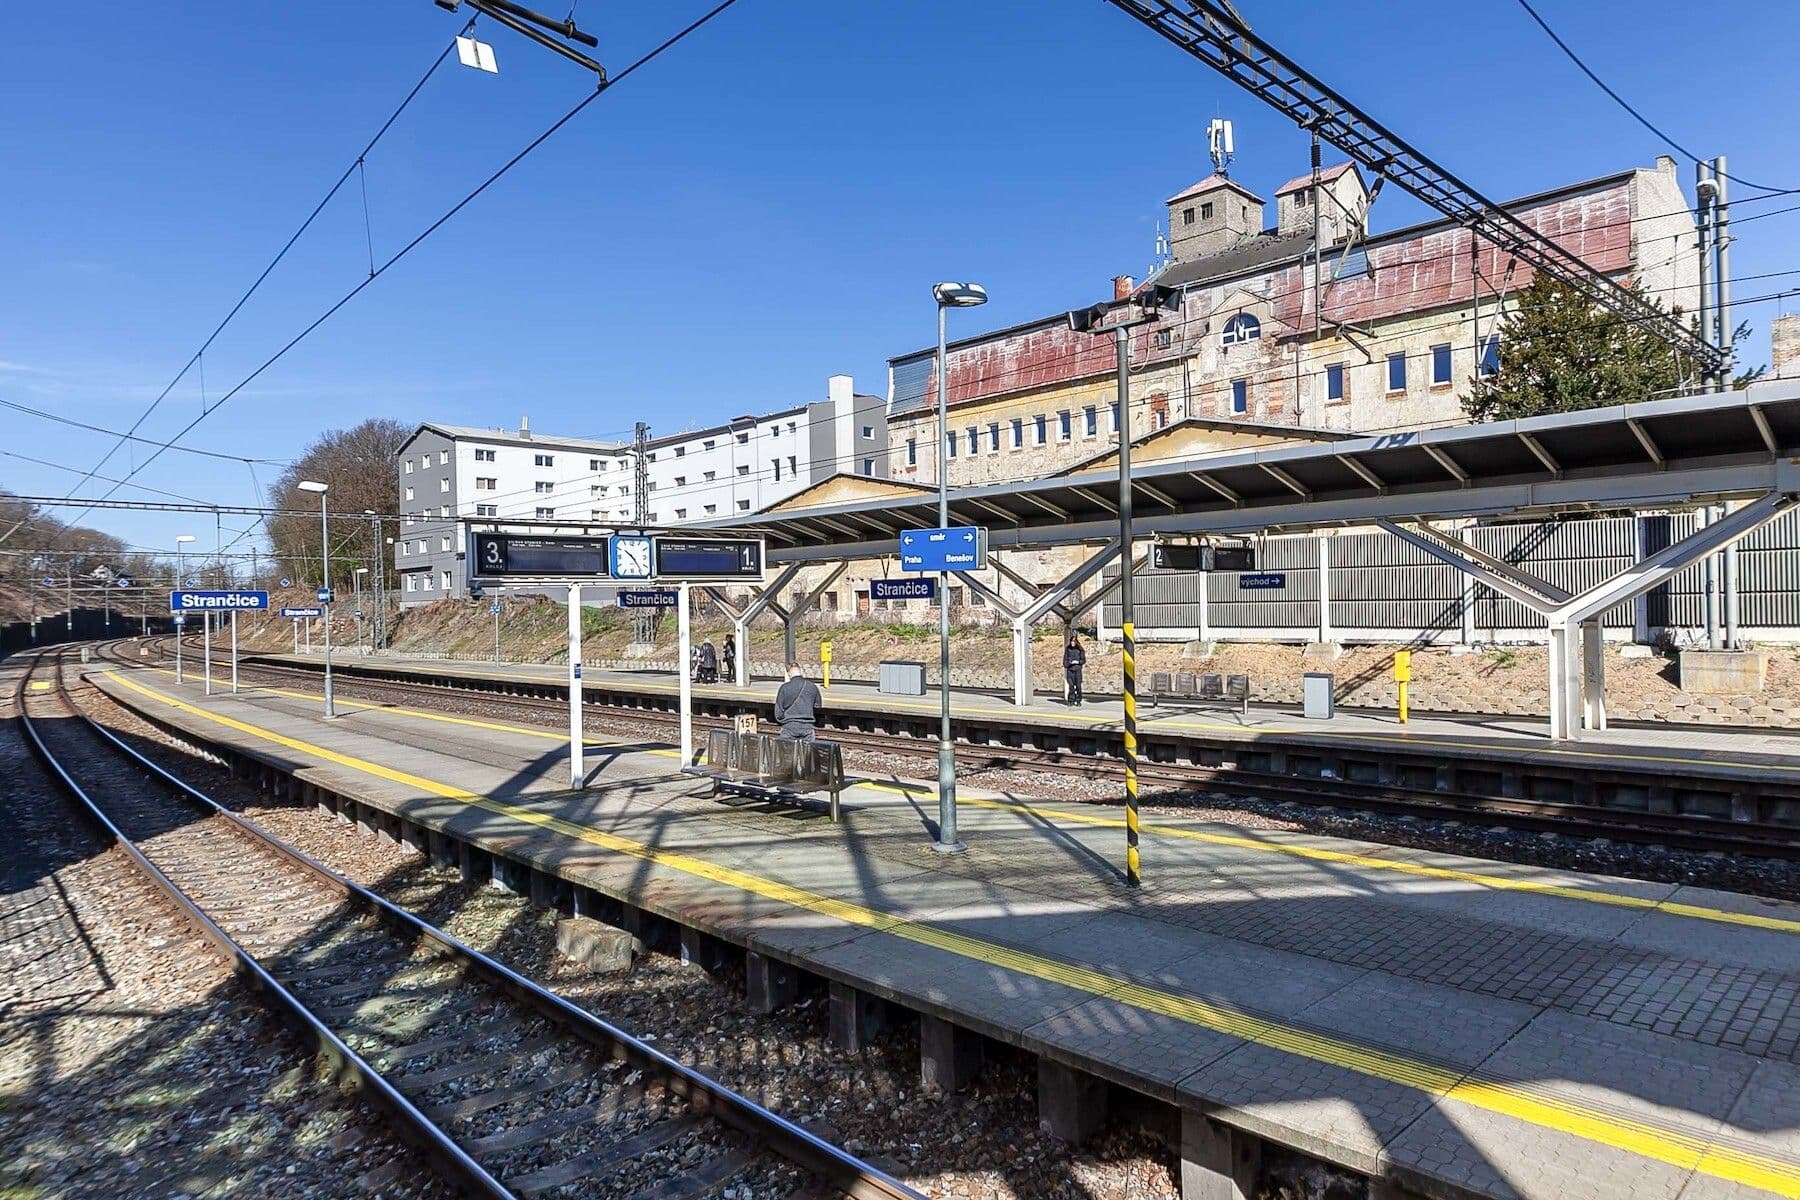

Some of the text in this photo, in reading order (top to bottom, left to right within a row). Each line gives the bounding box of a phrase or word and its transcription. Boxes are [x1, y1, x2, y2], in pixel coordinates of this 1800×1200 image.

[487, 542, 503, 563] 3.
[743, 547, 754, 566] 1.
[904, 556, 922, 564] Praha
[945, 554, 974, 563] Benešov
[1240, 578, 1270, 587] východ
[876, 582, 928, 596] Strančice
[181, 594, 259, 607] Strančice
[625, 594, 674, 605] Strančice
[284, 608, 319, 616] Strančice
[741, 717, 755, 728] 157
